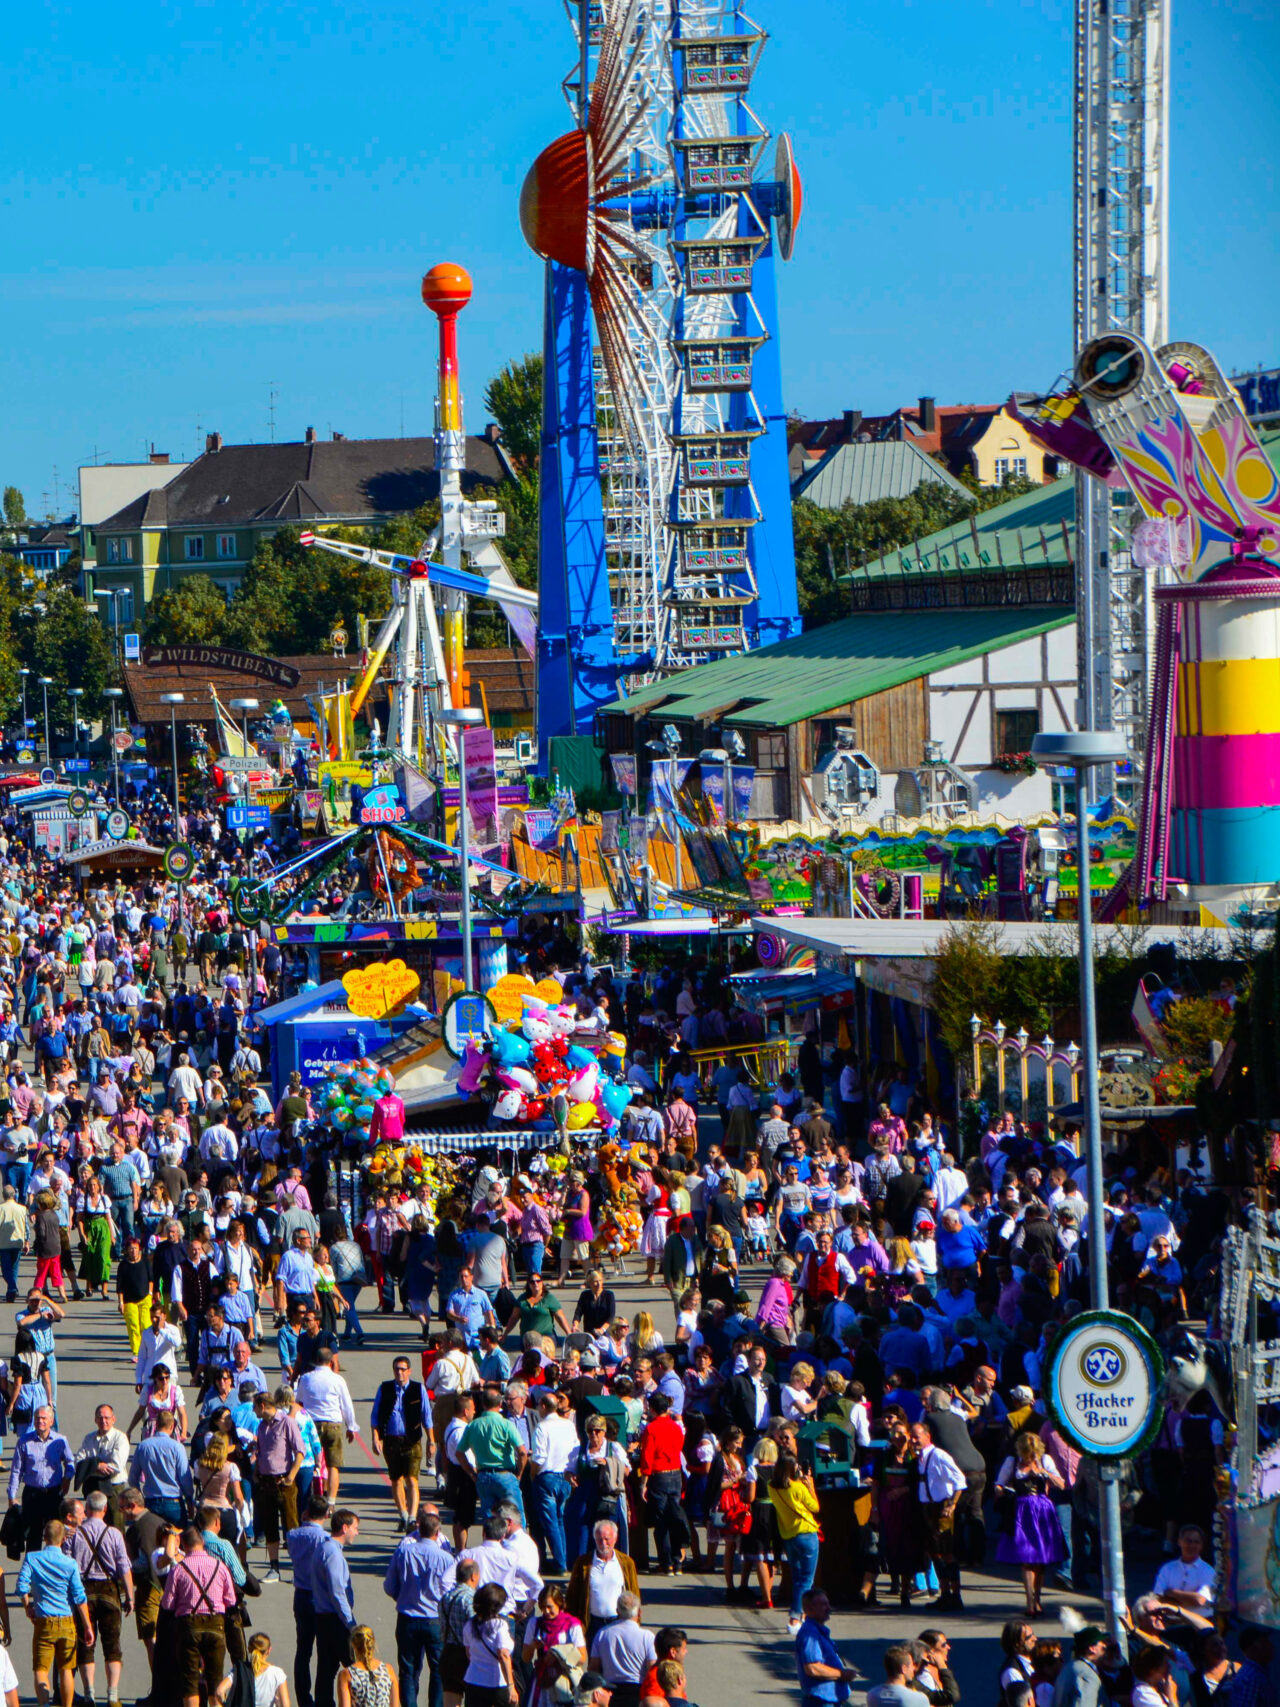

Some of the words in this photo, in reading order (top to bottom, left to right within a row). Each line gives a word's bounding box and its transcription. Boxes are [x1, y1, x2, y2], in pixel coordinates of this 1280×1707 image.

[166, 649, 278, 680] WILDSTUBEN
[229, 759, 262, 768] Polizei
[232, 810, 244, 823] U
[360, 806, 405, 823] SHOP
[1076, 1392, 1135, 1411] Hacker
[1084, 1411, 1128, 1428] Bräu
